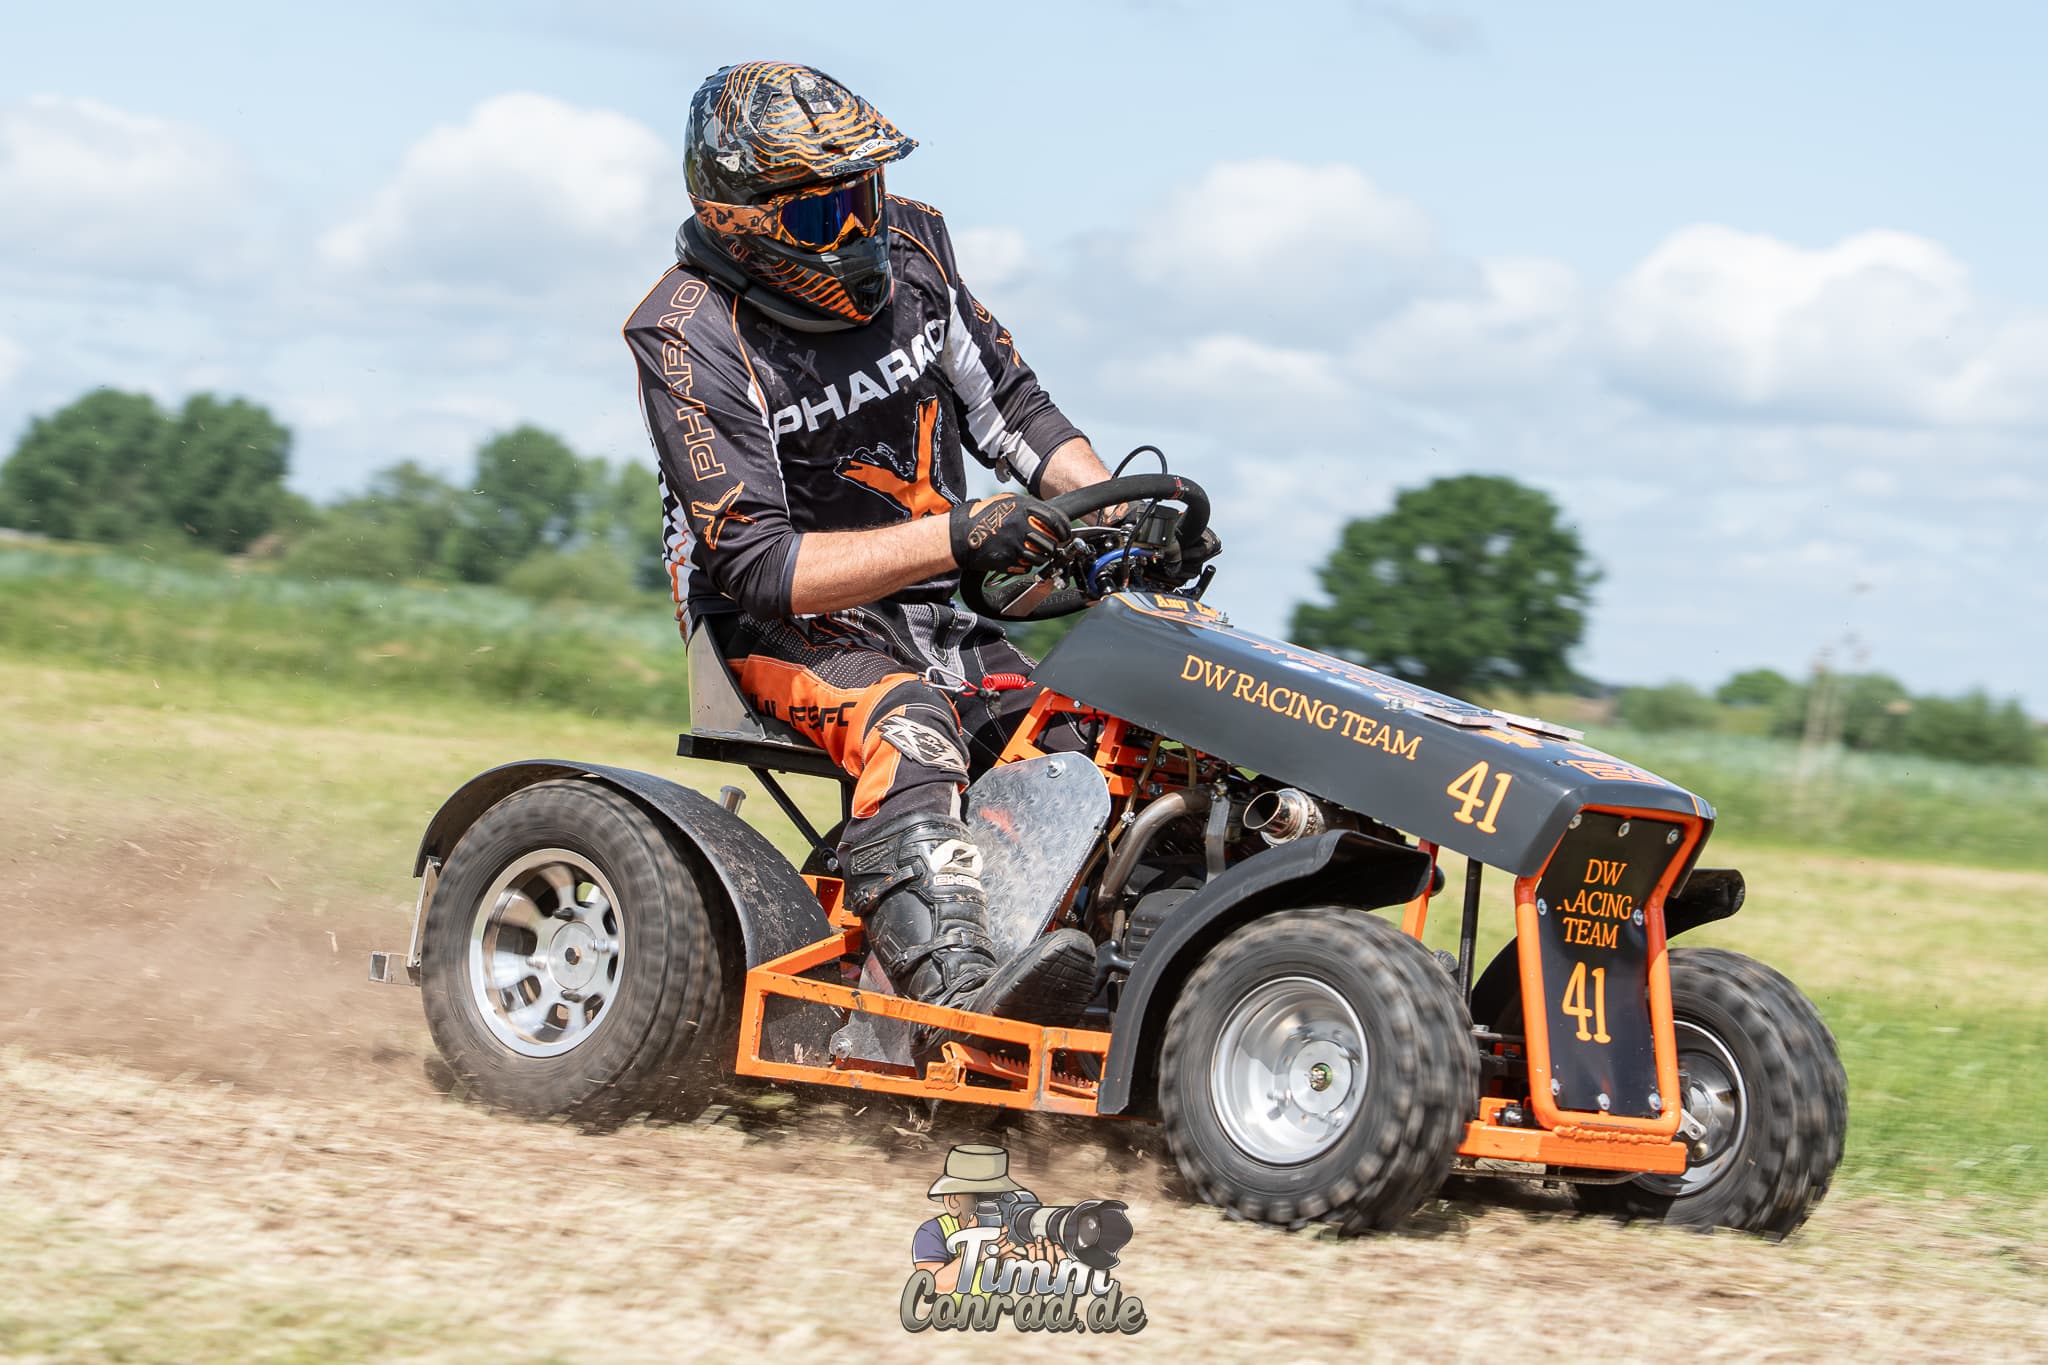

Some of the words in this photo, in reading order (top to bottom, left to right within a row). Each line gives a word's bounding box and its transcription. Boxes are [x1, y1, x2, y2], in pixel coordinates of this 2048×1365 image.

[1180, 654, 1235, 692] DW
[1232, 672, 1340, 731] RACING
[1340, 709, 1424, 761] TEAM
[1446, 759, 1514, 834] 41
[1583, 858, 1628, 887] DW
[1562, 917, 1620, 949] TEAM
[1561, 961, 1612, 1044] 41
